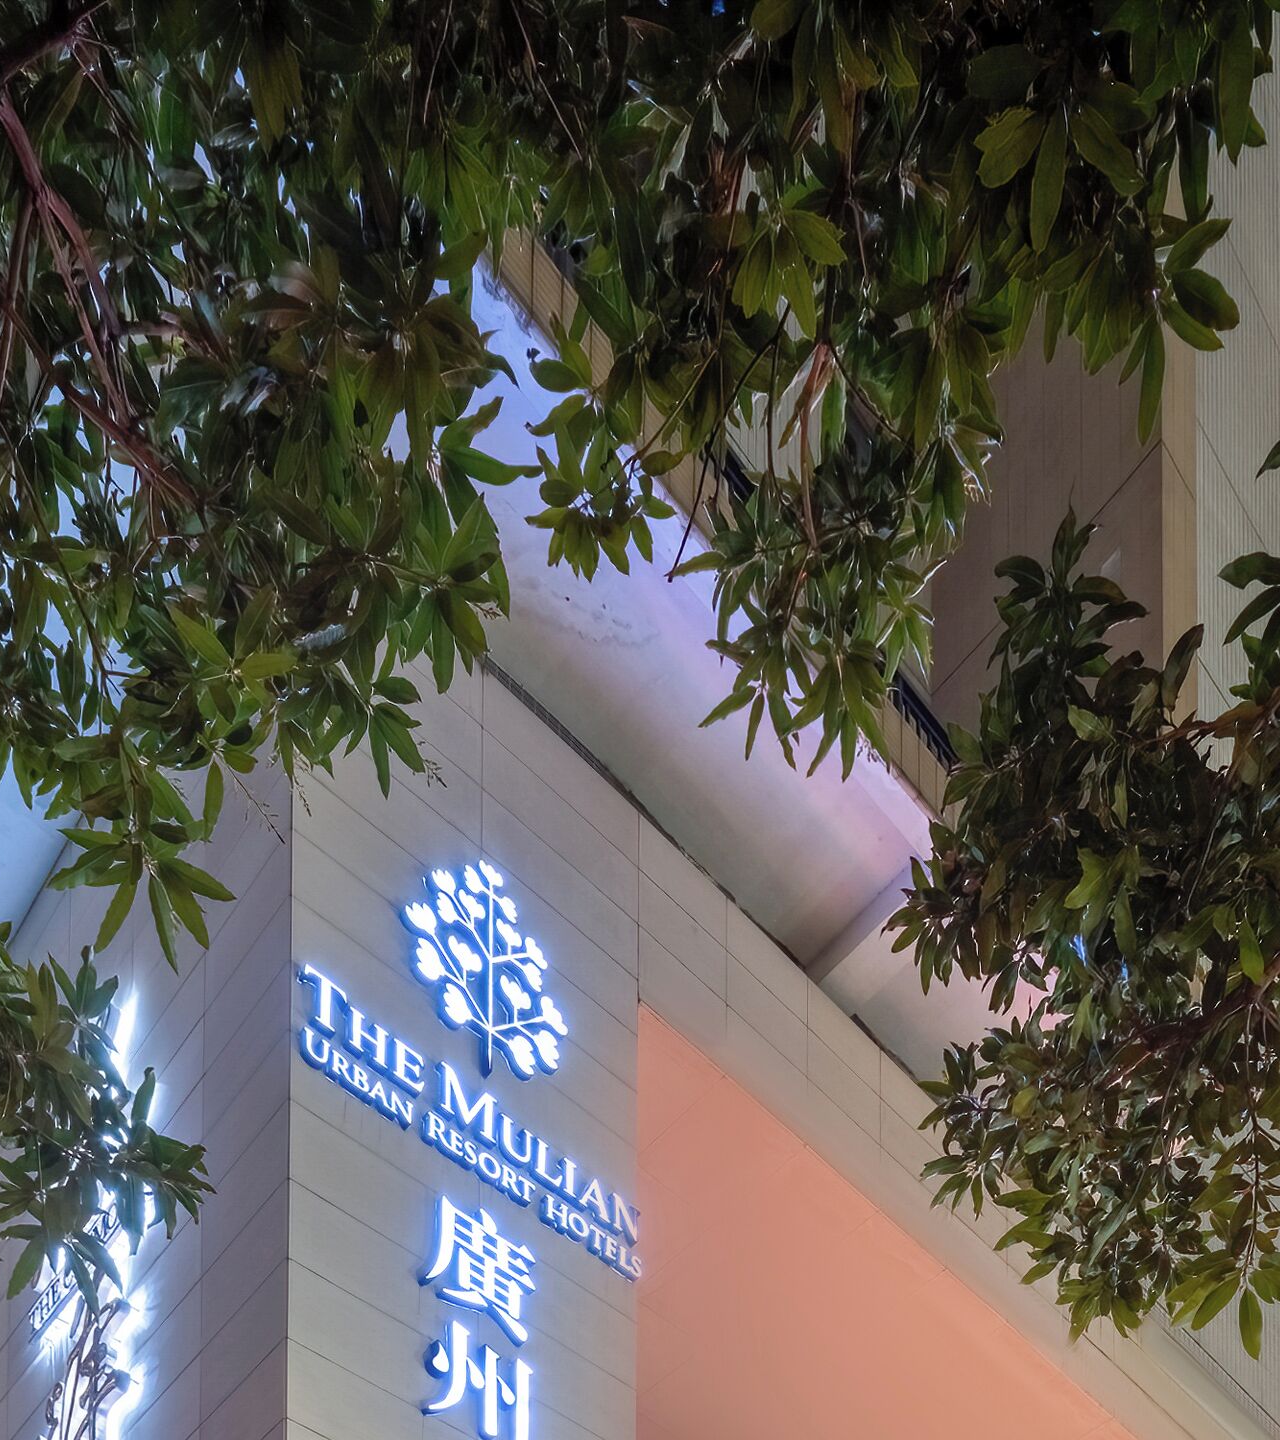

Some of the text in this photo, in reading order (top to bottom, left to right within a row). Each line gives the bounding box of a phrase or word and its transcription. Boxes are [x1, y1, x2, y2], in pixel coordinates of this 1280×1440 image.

[300, 962, 641, 1247] THE MULIAN
[301, 1027, 643, 1282] URBAN RESORT HOTELS
